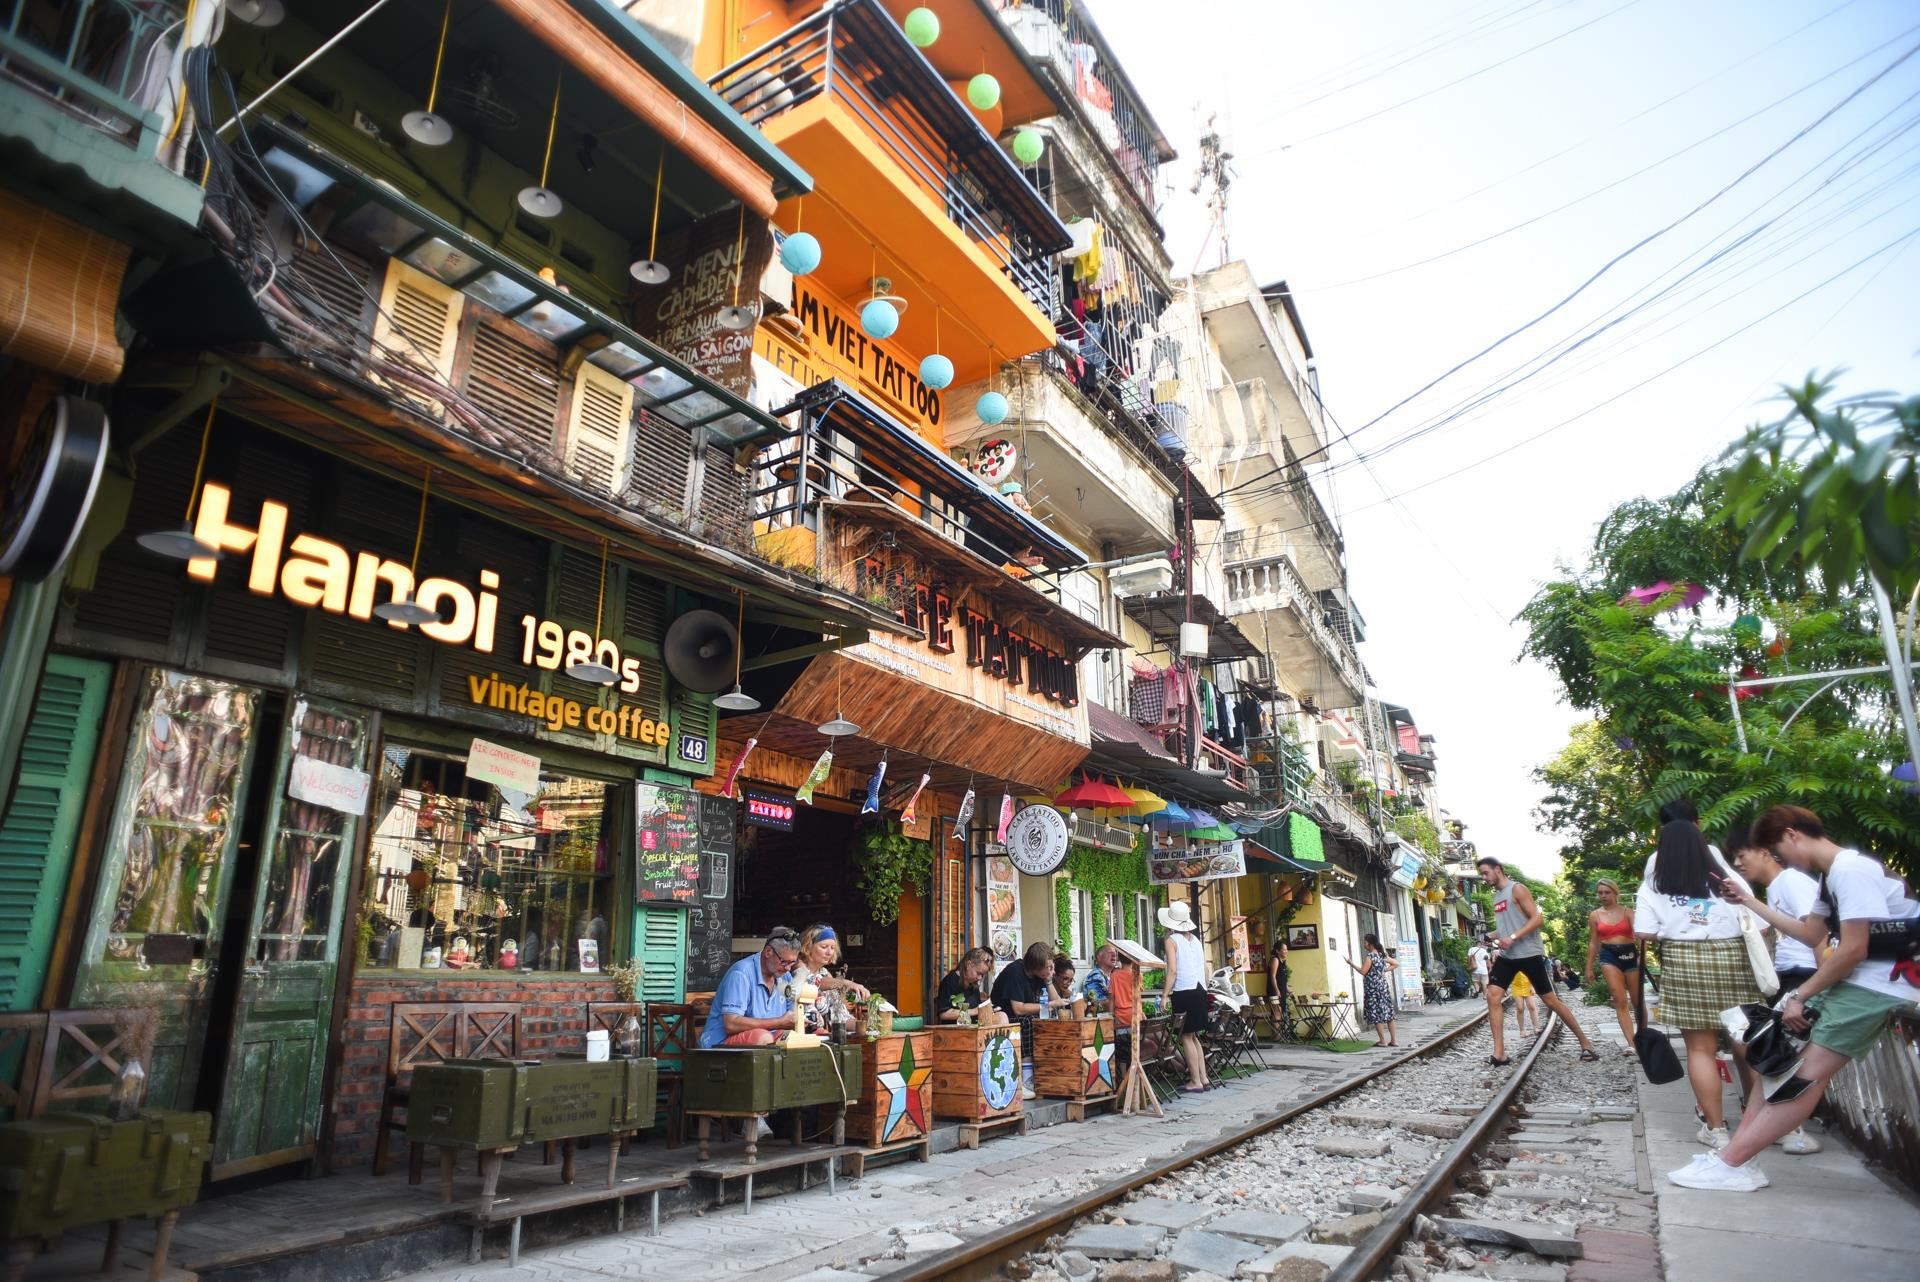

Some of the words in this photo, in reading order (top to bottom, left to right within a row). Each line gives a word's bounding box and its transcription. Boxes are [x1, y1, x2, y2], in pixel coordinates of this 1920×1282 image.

[823, 304, 867, 370] VIET
[871, 343, 940, 426] TATTOO
[186, 482, 500, 654] Hanoi
[521, 614, 640, 694] 1980s
[467, 672, 581, 732] vintage
[586, 705, 670, 747] coffee
[473, 743, 488, 753] AIR
[685, 740, 703, 760] 48
[749, 799, 792, 820] TATTOO
[1012, 809, 1031, 829] CAFE
[1031, 808, 1061, 828] TATTOO
[1010, 847, 1021, 862] LAM
[1020, 860, 1037, 872] VIET
[1040, 845, 1061, 871] TATTOO
